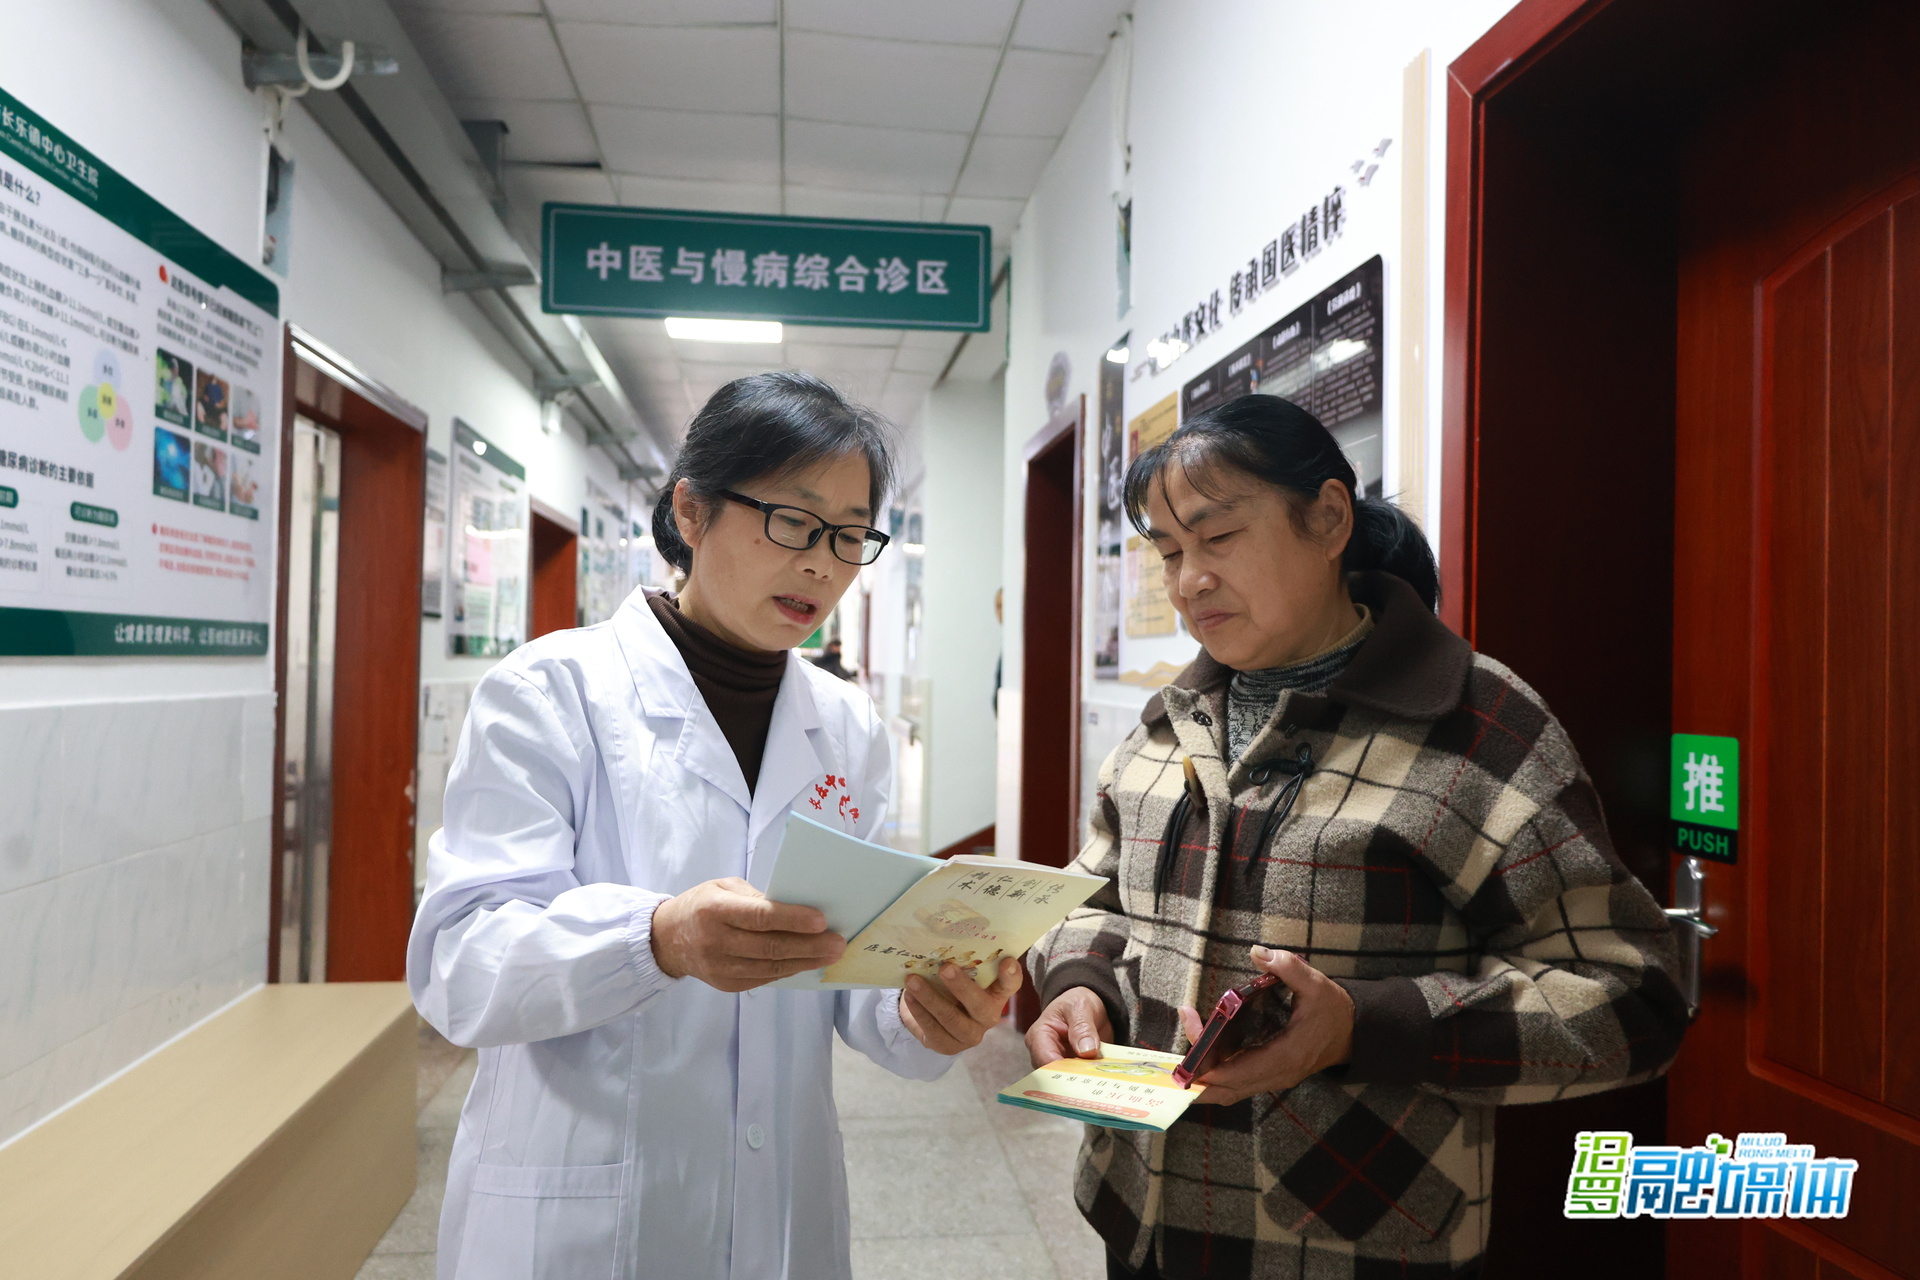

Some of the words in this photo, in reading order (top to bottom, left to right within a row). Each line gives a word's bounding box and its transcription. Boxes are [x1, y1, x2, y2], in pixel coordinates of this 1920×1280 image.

[0, 102, 98, 189] 长乐镇中心卫生院
[586, 242, 949, 295] 中医与慢病综合诊区
[1683, 752, 1724, 813] 推
[1678, 828, 1728, 856] PUSH
